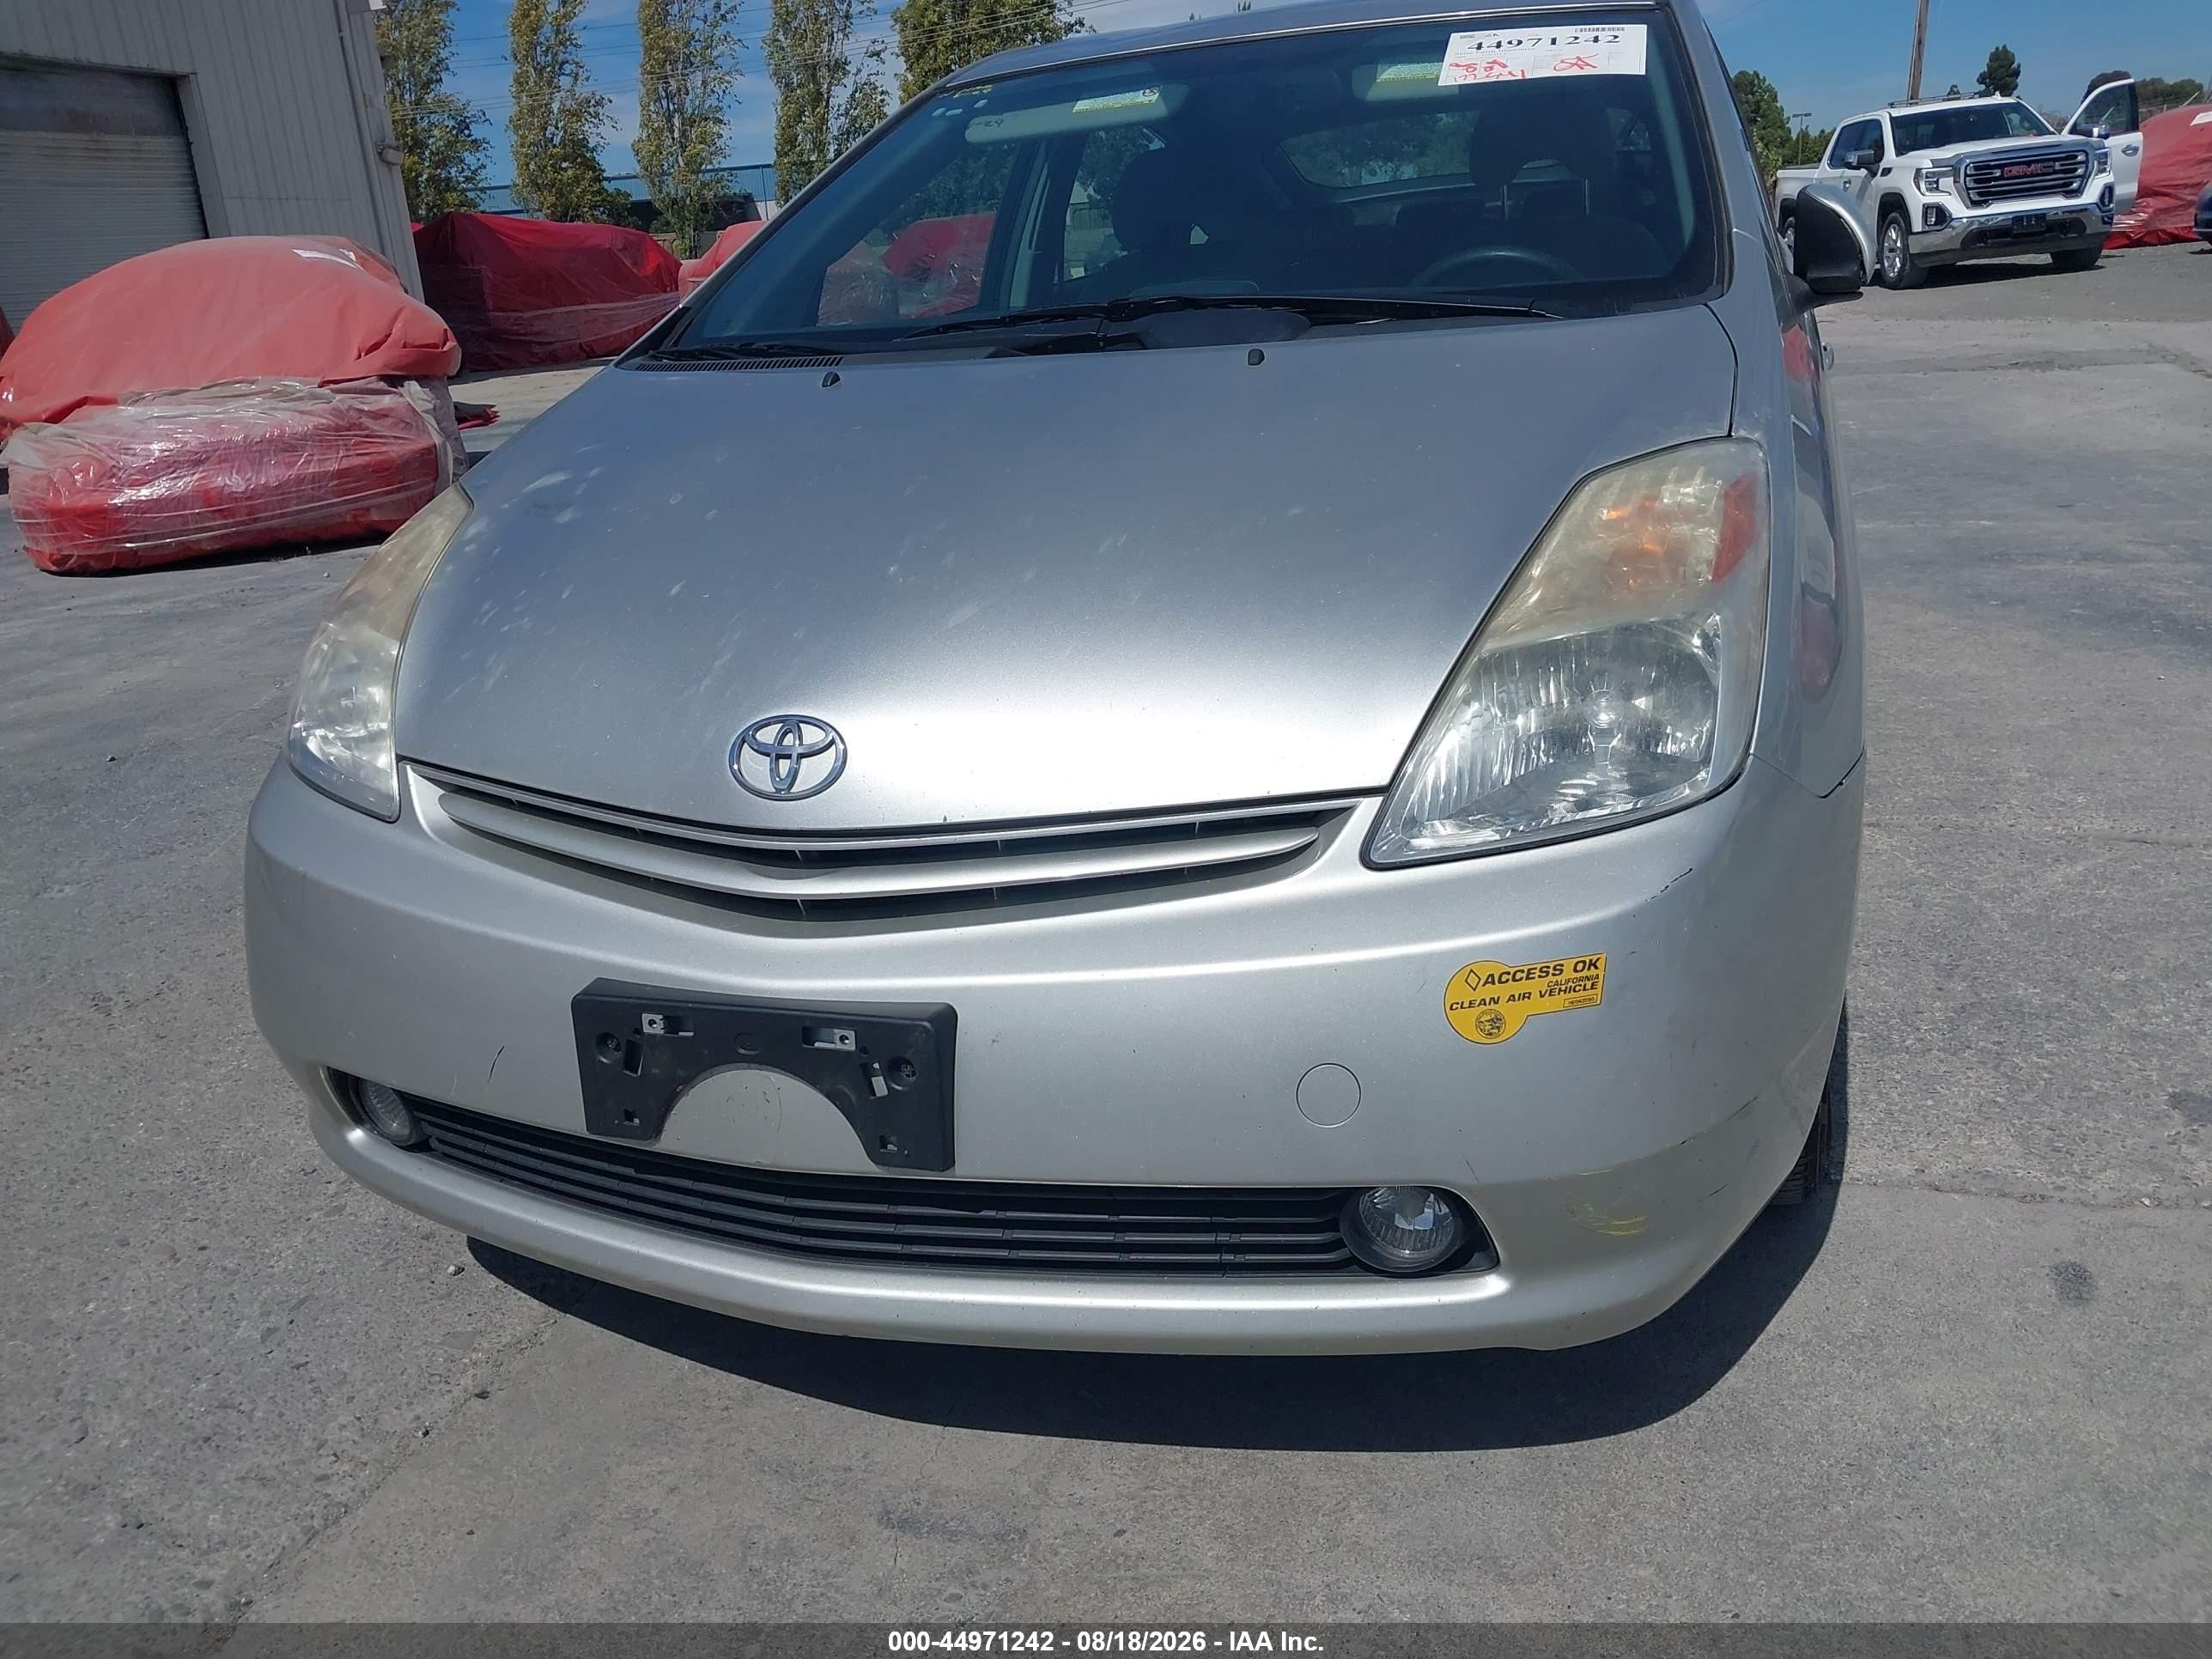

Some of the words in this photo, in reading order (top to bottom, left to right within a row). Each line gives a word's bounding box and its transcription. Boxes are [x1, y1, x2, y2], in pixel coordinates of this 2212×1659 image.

[1467, 33, 1621, 52] 44971242
[2004, 161, 2055, 178] GMC
[1482, 963, 1565, 987] ACCESS
[1572, 957, 1601, 973] OK
[1547, 973, 1600, 988] CALIFORNIA
[1449, 995, 1500, 1012] CLEAN
[1505, 991, 1532, 1004] AIR
[1538, 981, 1599, 999] VEHICLE
